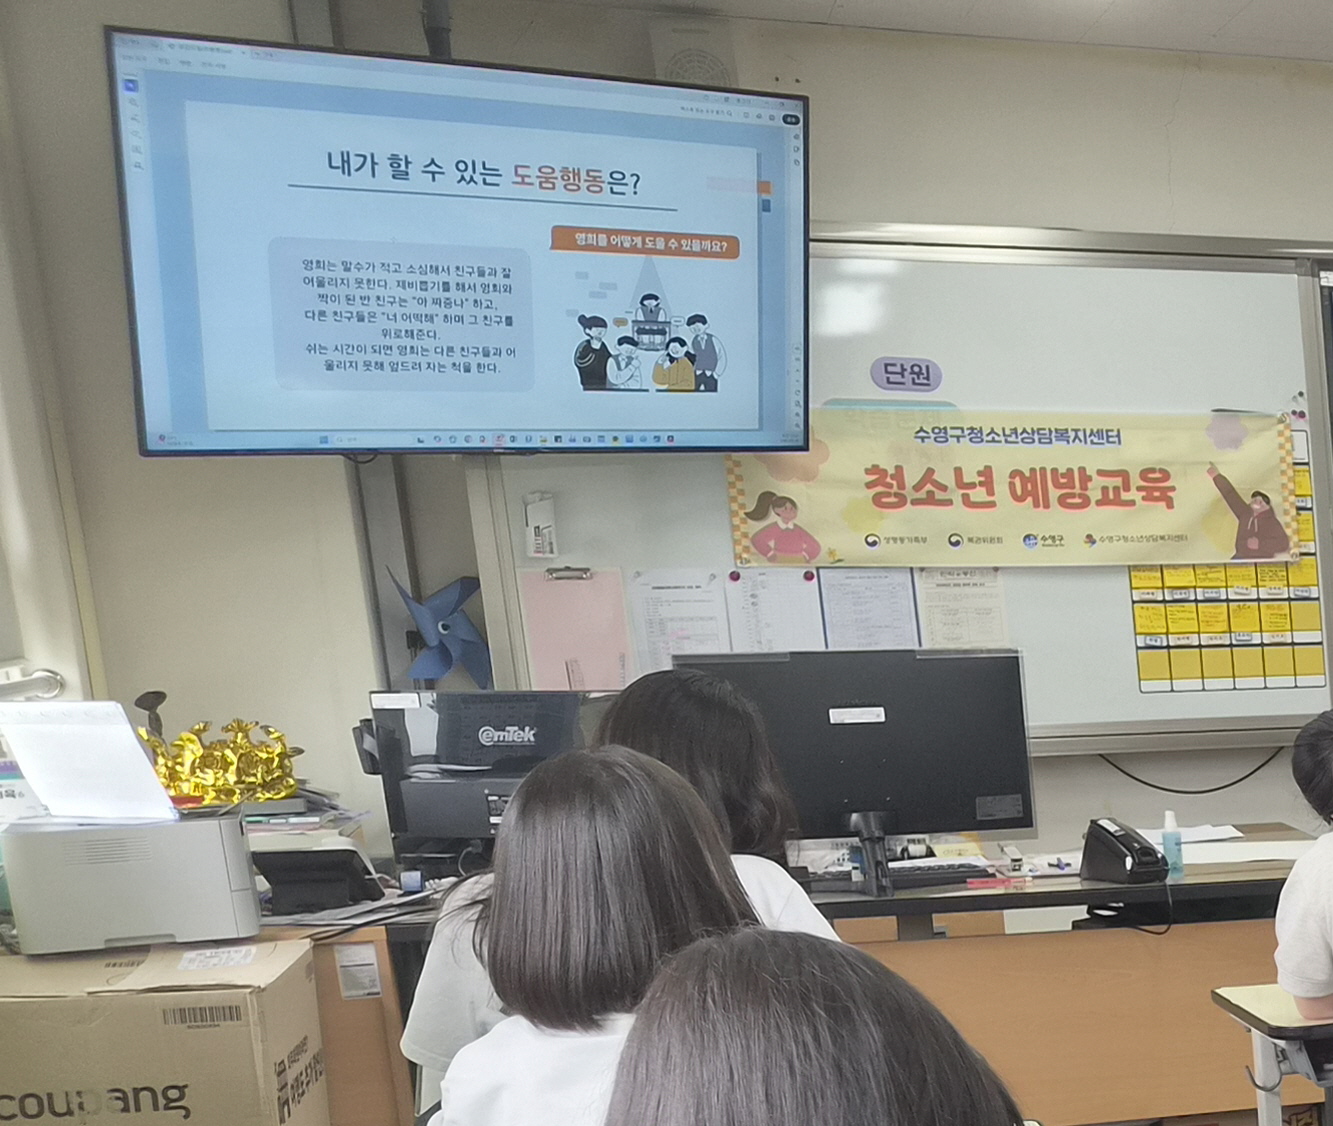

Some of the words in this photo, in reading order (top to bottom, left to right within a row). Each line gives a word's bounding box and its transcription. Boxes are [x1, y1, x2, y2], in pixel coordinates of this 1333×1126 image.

[327, 151, 379, 178] 내가
[387, 154, 413, 181] 할
[422, 158, 446, 182] 수
[454, 159, 502, 187] 있는
[512, 163, 641, 196] 도움행동은?
[575, 232, 607, 247] 영희를
[645, 236, 666, 250] 도울
[668, 237, 679, 250] 수
[681, 237, 727, 253] 있을까요?
[302, 259, 336, 271] 영희는
[342, 261, 375, 272] 말수가
[381, 263, 401, 273] 적고
[407, 265, 451, 276] 소심해서
[454, 265, 497, 278] 친구들과
[501, 267, 511, 279] 잘
[303, 277, 350, 288] 어울리지
[355, 278, 391, 290] 못한다.
[455, 282, 476, 293] 해서
[481, 283, 512, 294] 영희와
[345, 295, 356, 306] 된
[360, 295, 370, 306] 반
[376, 296, 408, 307] 친구는
[305, 310, 328, 322] 다른
[333, 311, 377, 323] 친구들은
[443, 314, 464, 325] 하며
[469, 315, 478, 325] 그
[483, 315, 513, 327] 친구를
[382, 329, 440, 340] 위로해준다.
[306, 343, 328, 354] 쉬는
[334, 344, 367, 355] 시간이
[371, 344, 393, 355] 되면
[397, 345, 430, 356] 영희는
[434, 346, 455, 357] 다른
[460, 346, 502, 358] 친구들과
[506, 348, 516, 358] 어
[325, 360, 358, 371] 울리지
[363, 360, 384, 371] 못해
[388, 361, 422, 372] 엎드려
[426, 362, 446, 372] 자는
[451, 362, 472, 373] 척을
[477, 362, 501, 373] 한다.
[883, 362, 931, 386] 단원
[914, 427, 1122, 445] 수영구청소년상담복지센터
[864, 464, 997, 510] 청소년
[1009, 466, 1176, 510] 예방교육
[1040, 534, 1064, 544] 수영구
[0, 1083, 191, 1121] couang
